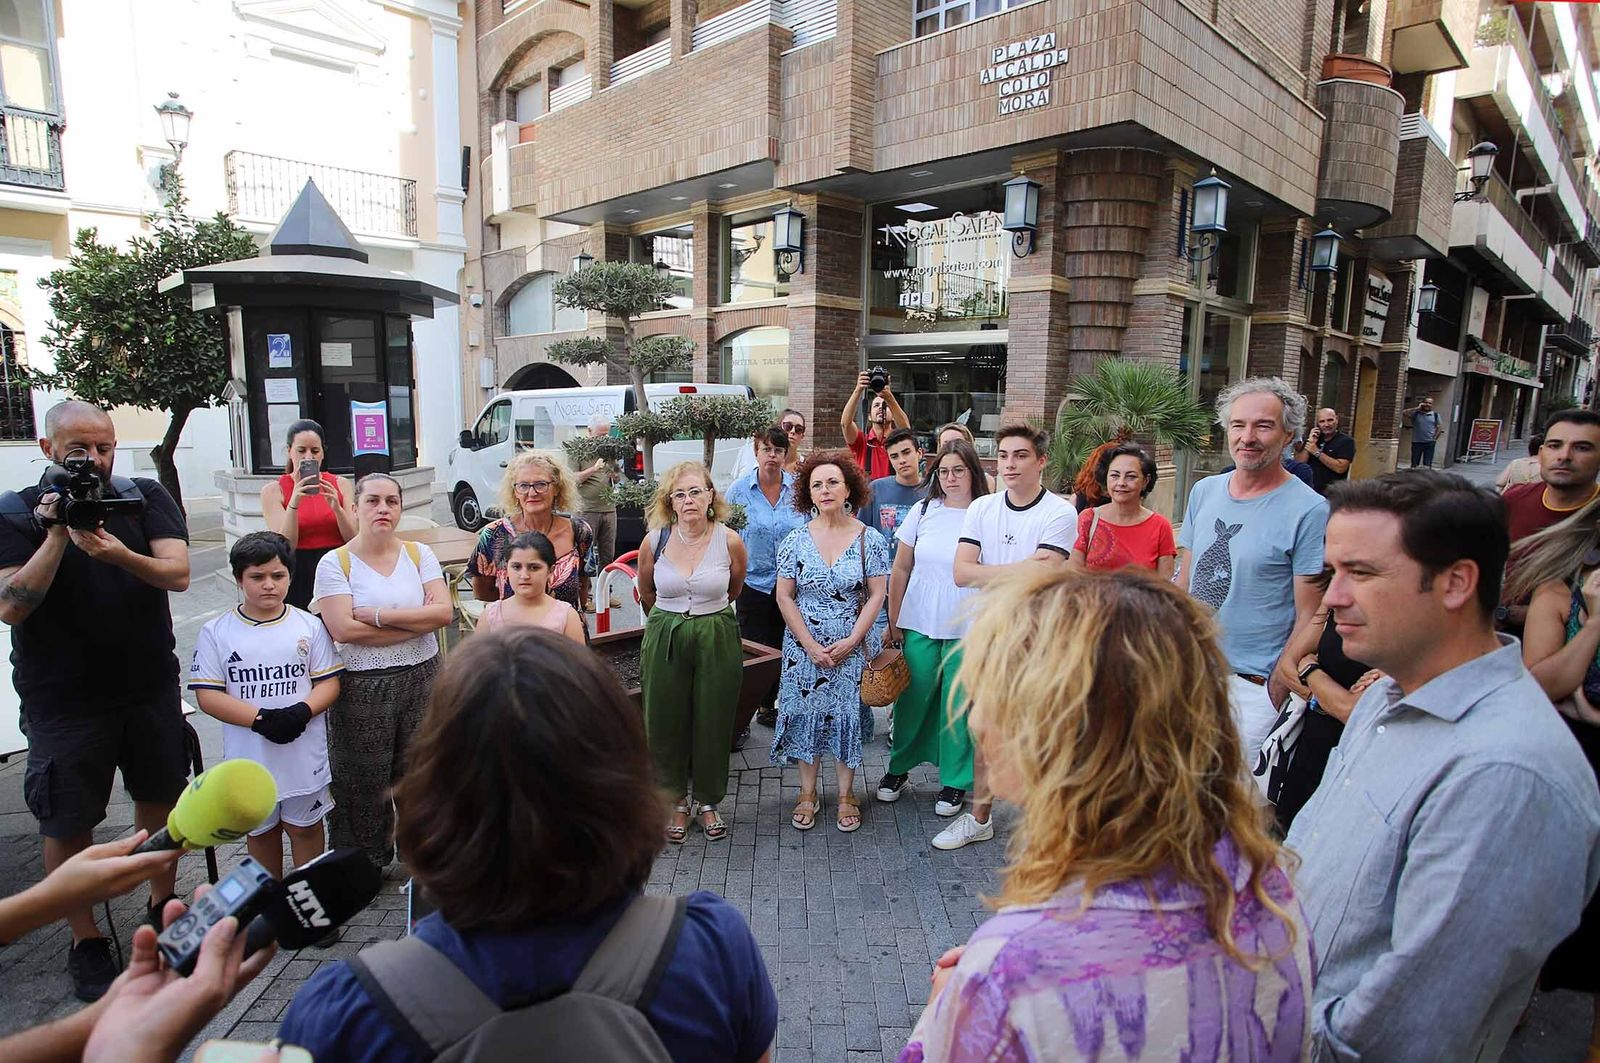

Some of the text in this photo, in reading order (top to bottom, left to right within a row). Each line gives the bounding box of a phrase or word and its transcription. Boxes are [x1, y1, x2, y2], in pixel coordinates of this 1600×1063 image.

[994, 34, 1053, 62] PLAZA
[982, 49, 1066, 83] ALCALDE
[1000, 72, 1047, 95] COTO
[1000, 91, 1047, 113] MORA
[228, 663, 306, 683] Emirates
[240, 681, 297, 699] FLY BETTER
[287, 879, 331, 928] HTV
